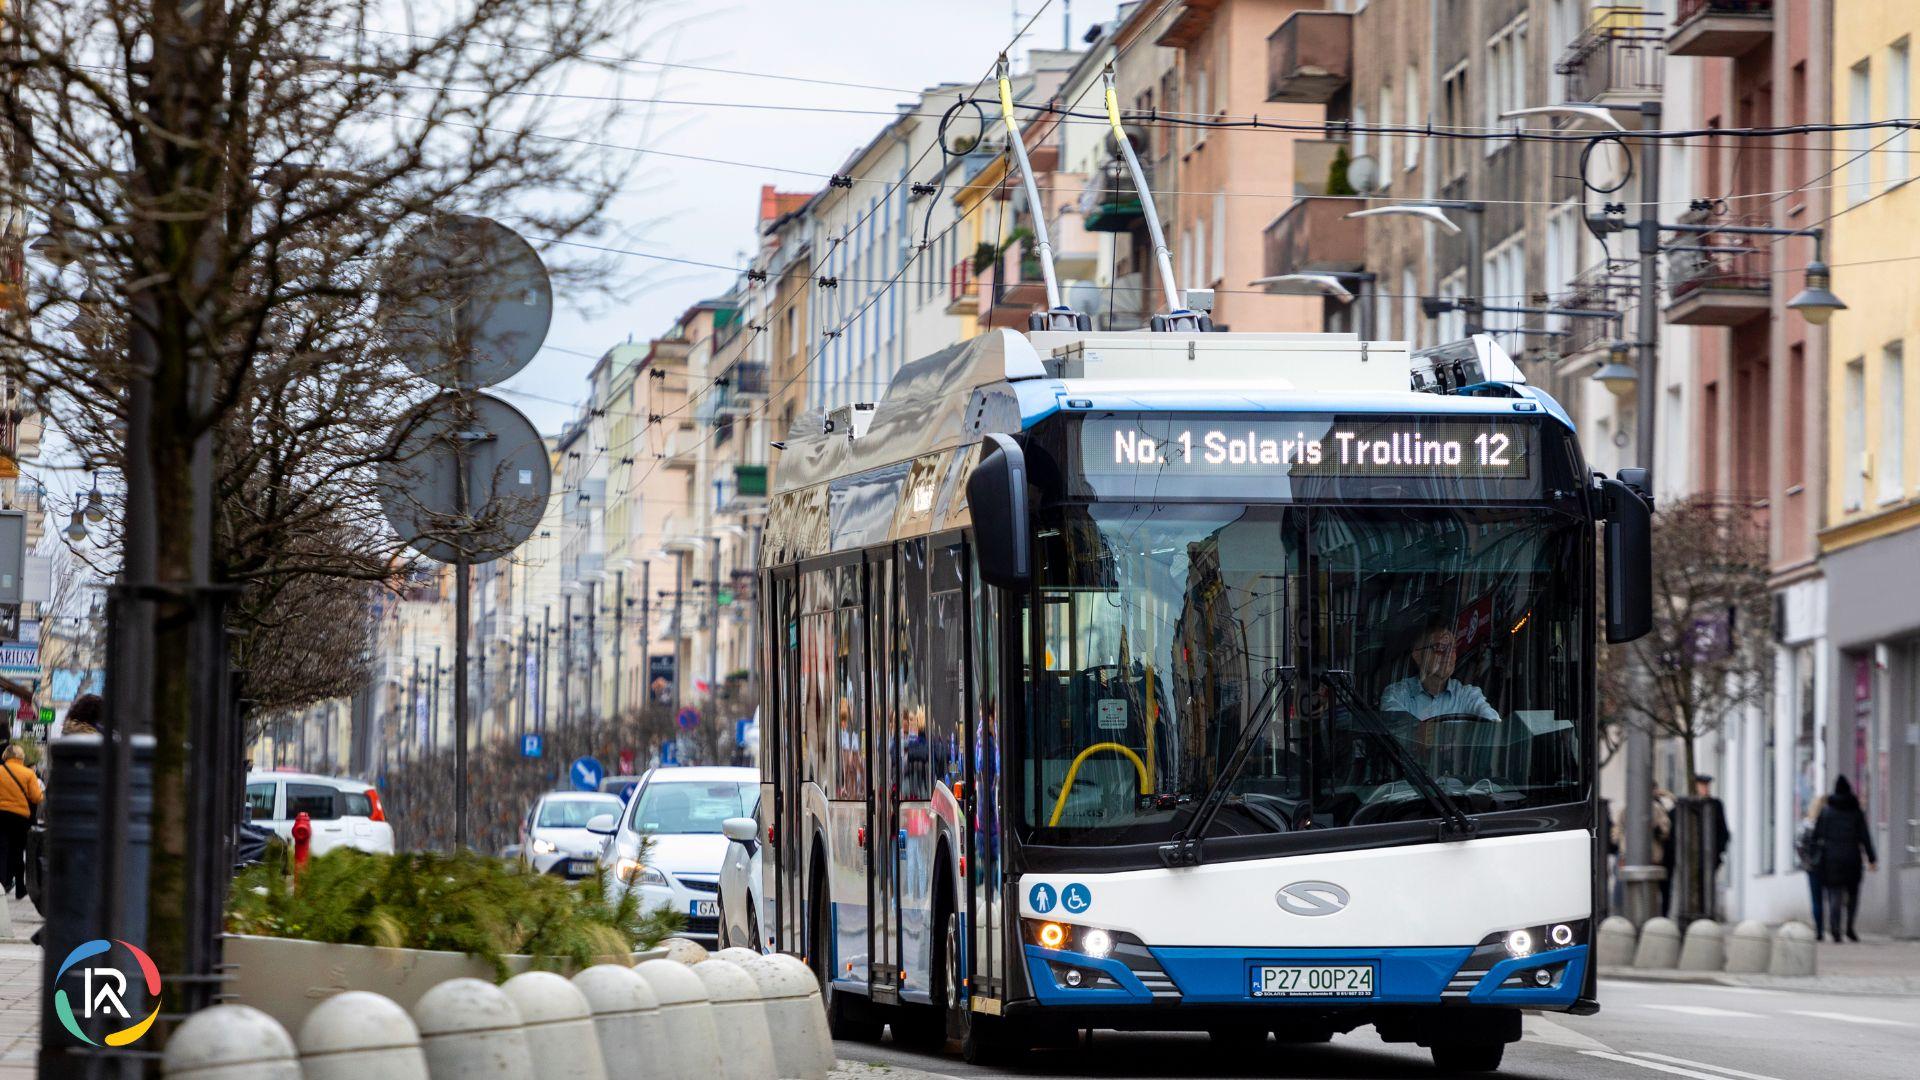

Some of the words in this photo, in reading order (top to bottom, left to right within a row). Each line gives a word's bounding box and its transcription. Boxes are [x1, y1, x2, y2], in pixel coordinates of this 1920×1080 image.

[1115, 430, 1165, 464] No.
[1178, 430, 1191, 464] 1
[1204, 430, 1322, 464] Solaris
[1335, 432, 1462, 465] Trollino
[1474, 432, 1510, 466] 12
[699, 902, 716, 915] GA
[1264, 969, 1302, 989] P27
